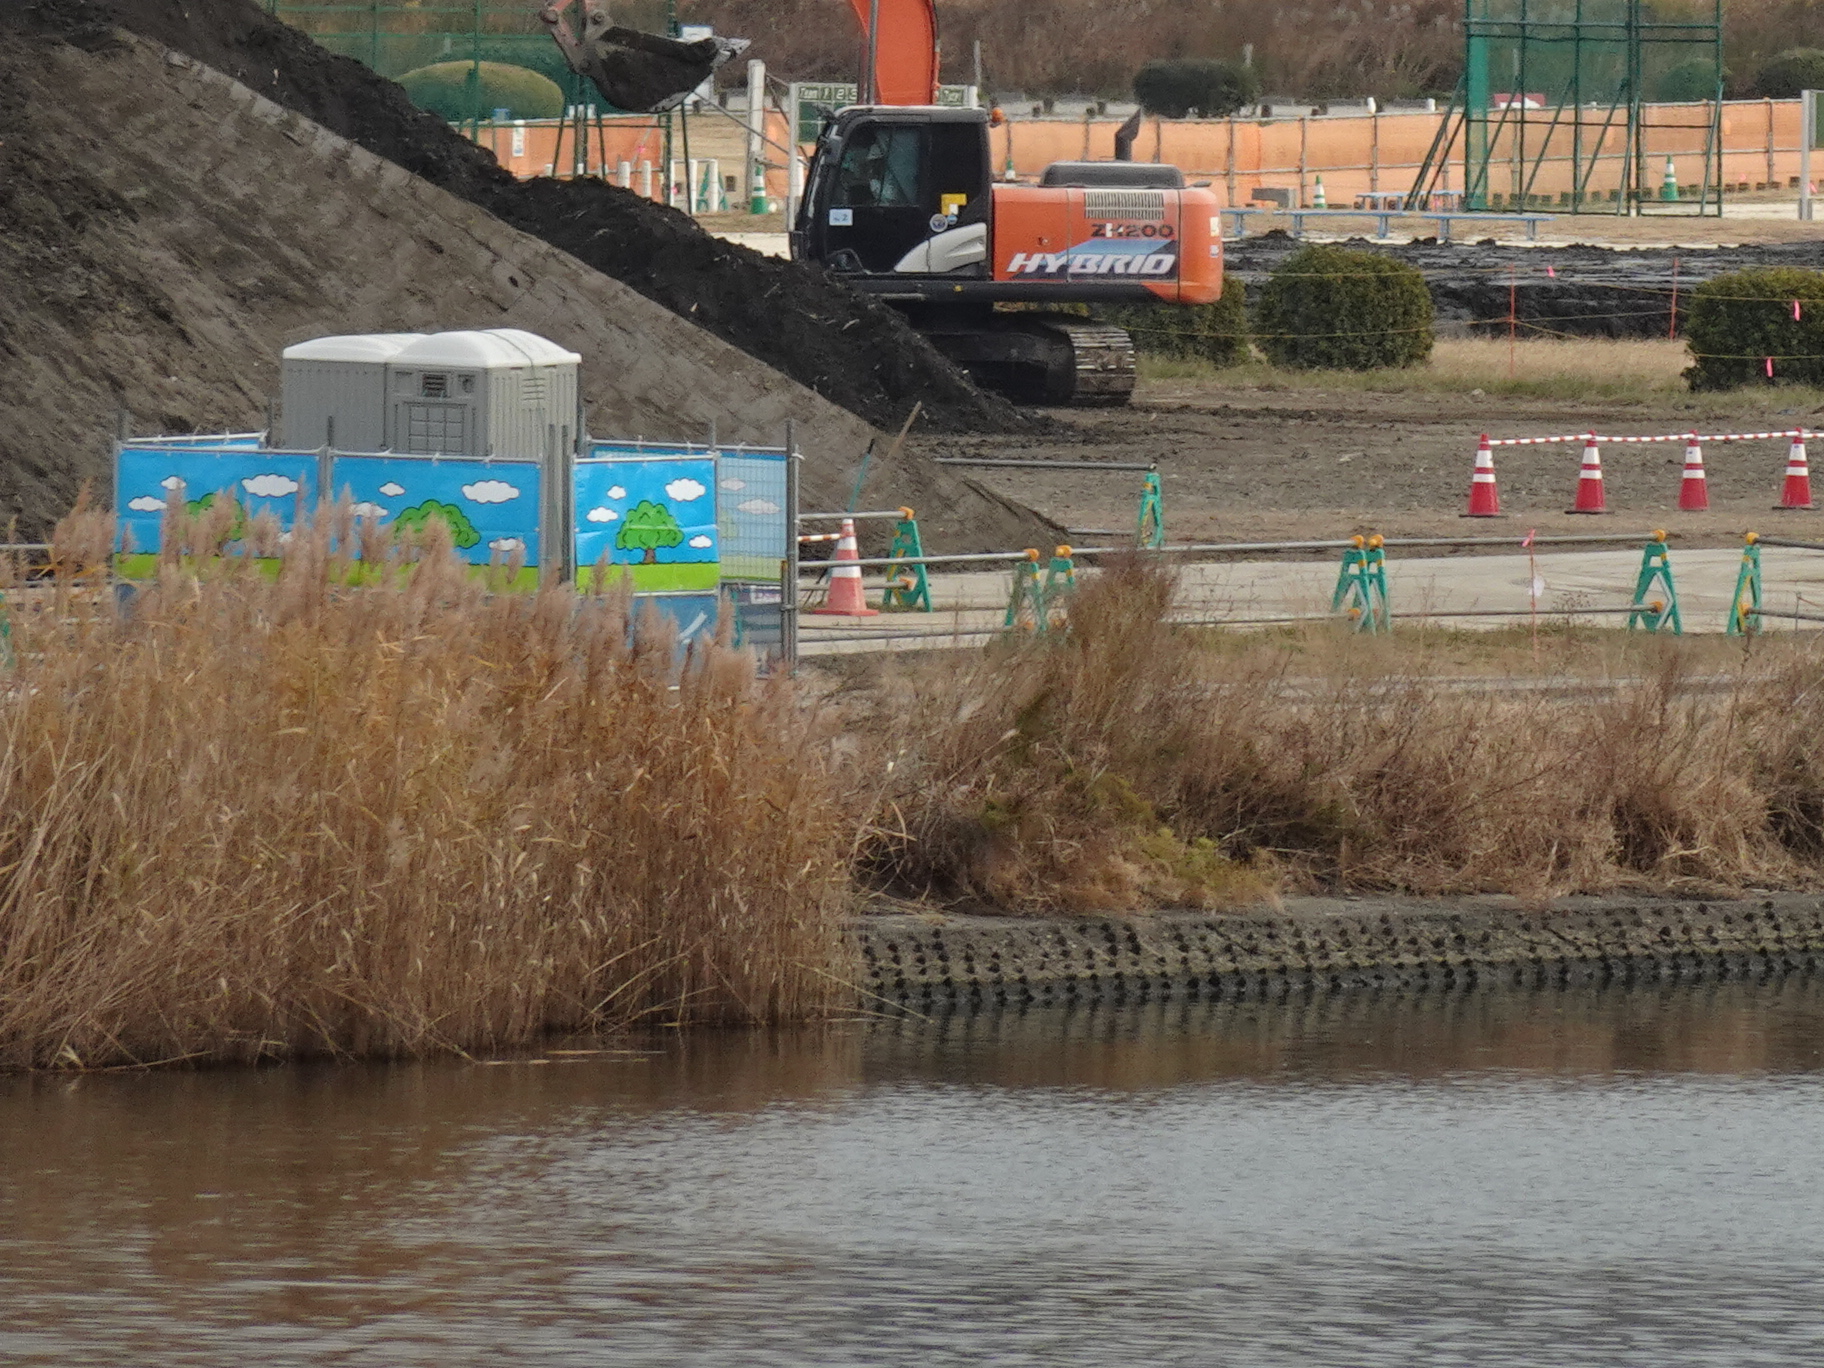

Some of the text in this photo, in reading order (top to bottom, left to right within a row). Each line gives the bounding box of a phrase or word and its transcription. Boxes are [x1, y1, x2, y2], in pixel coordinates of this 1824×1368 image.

[835, 86, 846, 100] 2
[1090, 222, 1175, 238] ZH200
[1006, 252, 1177, 276] HYBRID
